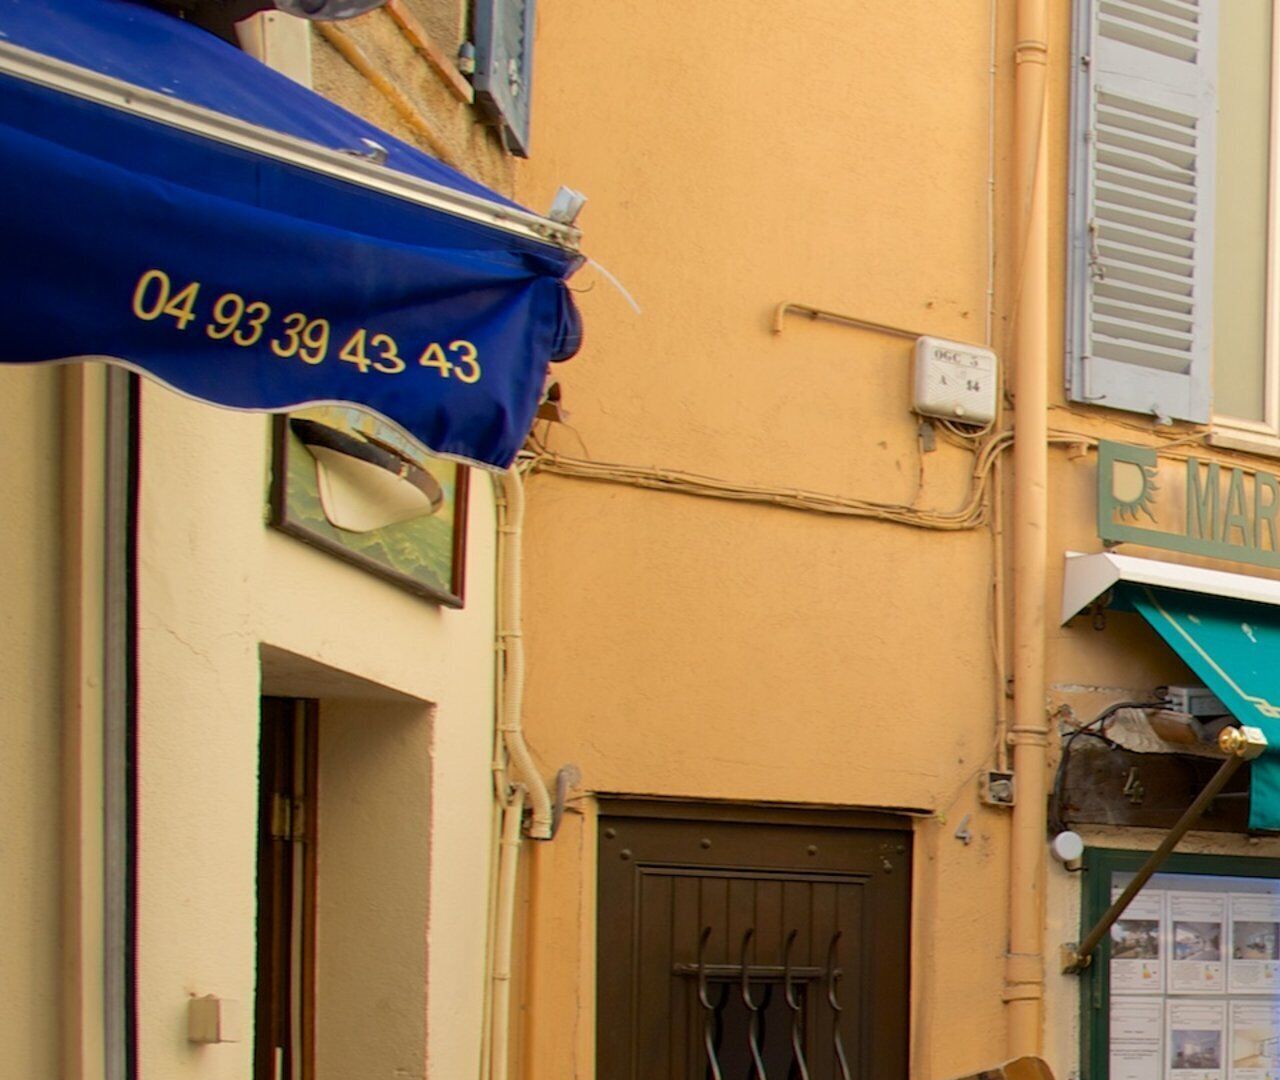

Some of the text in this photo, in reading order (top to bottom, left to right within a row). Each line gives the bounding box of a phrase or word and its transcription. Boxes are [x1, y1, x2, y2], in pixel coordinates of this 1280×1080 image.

[132, 269, 481, 384] 04 93 39 43 43
[1123, 767, 1144, 804] 4
